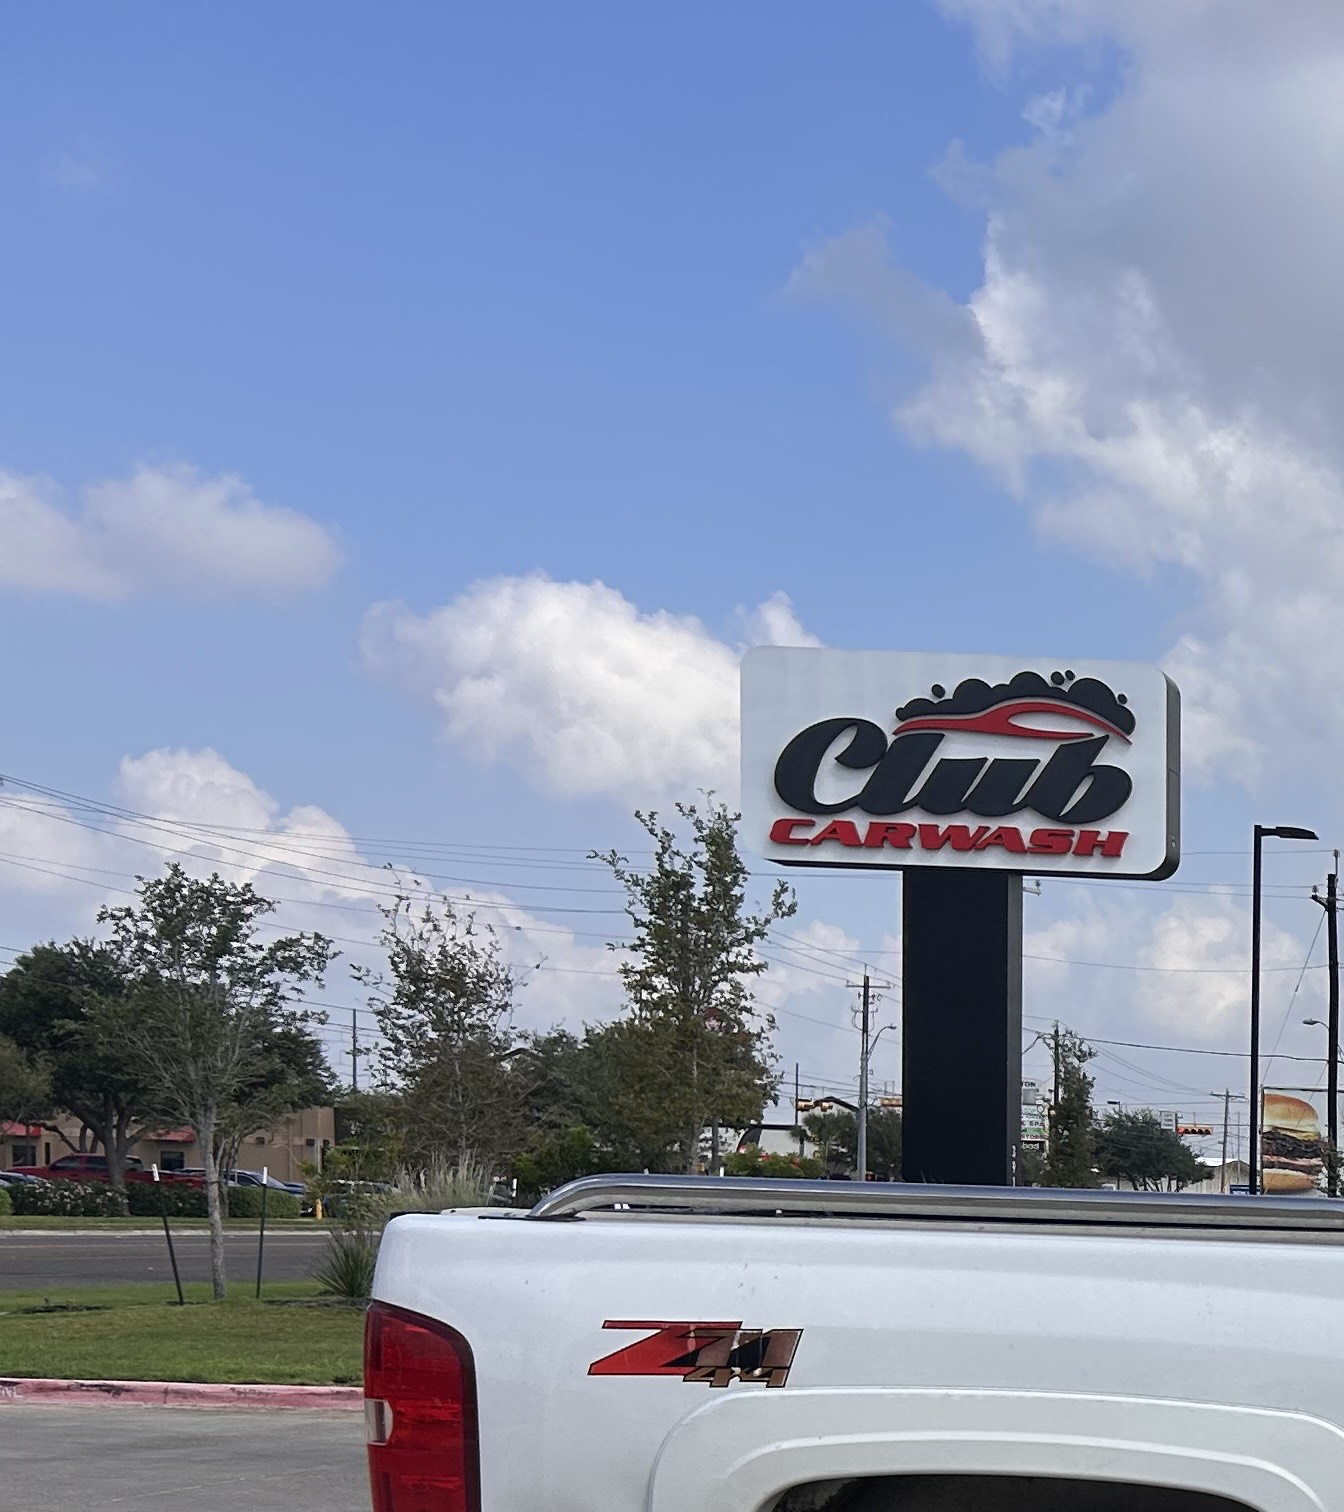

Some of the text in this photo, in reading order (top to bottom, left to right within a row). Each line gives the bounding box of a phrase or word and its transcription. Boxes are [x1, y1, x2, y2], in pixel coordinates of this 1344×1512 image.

[774, 717, 1132, 823] Club
[770, 818, 1129, 857] CARWASH
[588, 1320, 804, 1376] Z71
